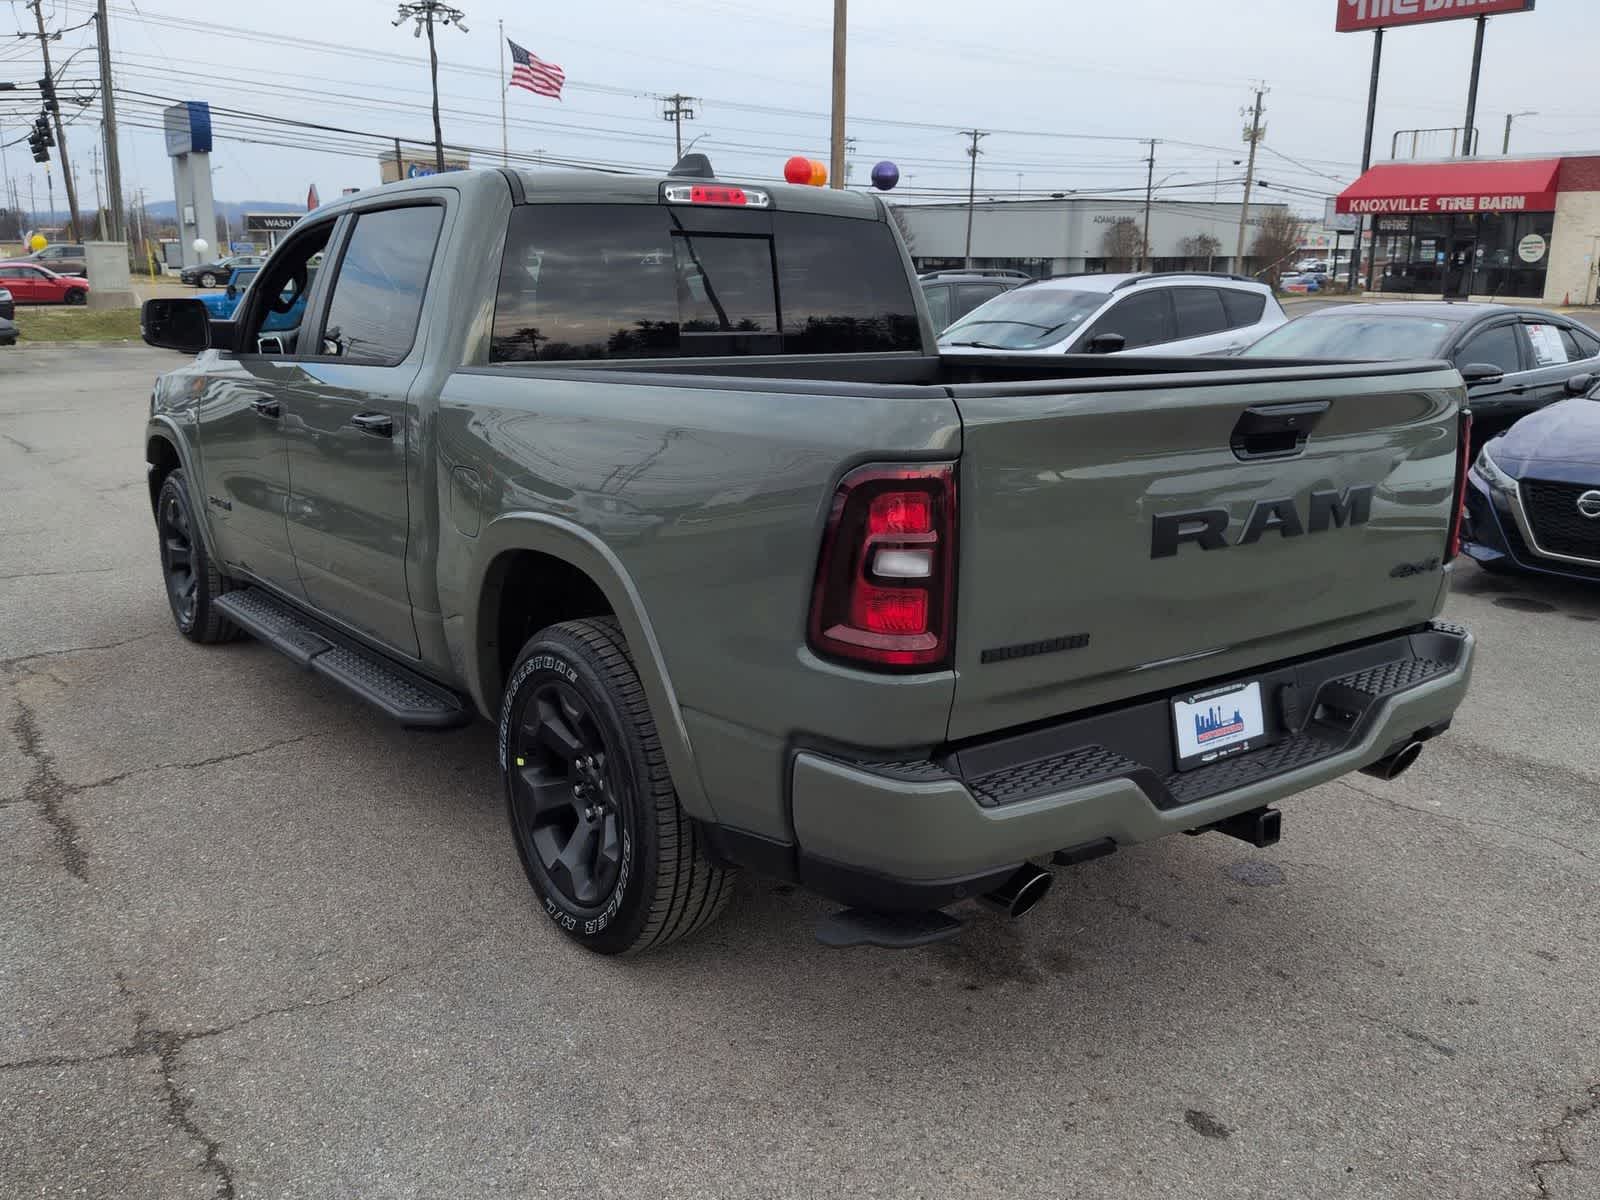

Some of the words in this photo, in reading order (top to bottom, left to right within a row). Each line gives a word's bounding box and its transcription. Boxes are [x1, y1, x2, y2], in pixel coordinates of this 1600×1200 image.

[264, 218, 292, 228] WASH
[1350, 198, 1429, 211] KNOXVILLE
[1436, 197, 1475, 211] TIRE
[1479, 196, 1526, 210] BARN
[1150, 485, 1373, 559] RAM
[500, 656, 578, 770] BRIDGESTONE
[585, 828, 631, 934] DUELER
